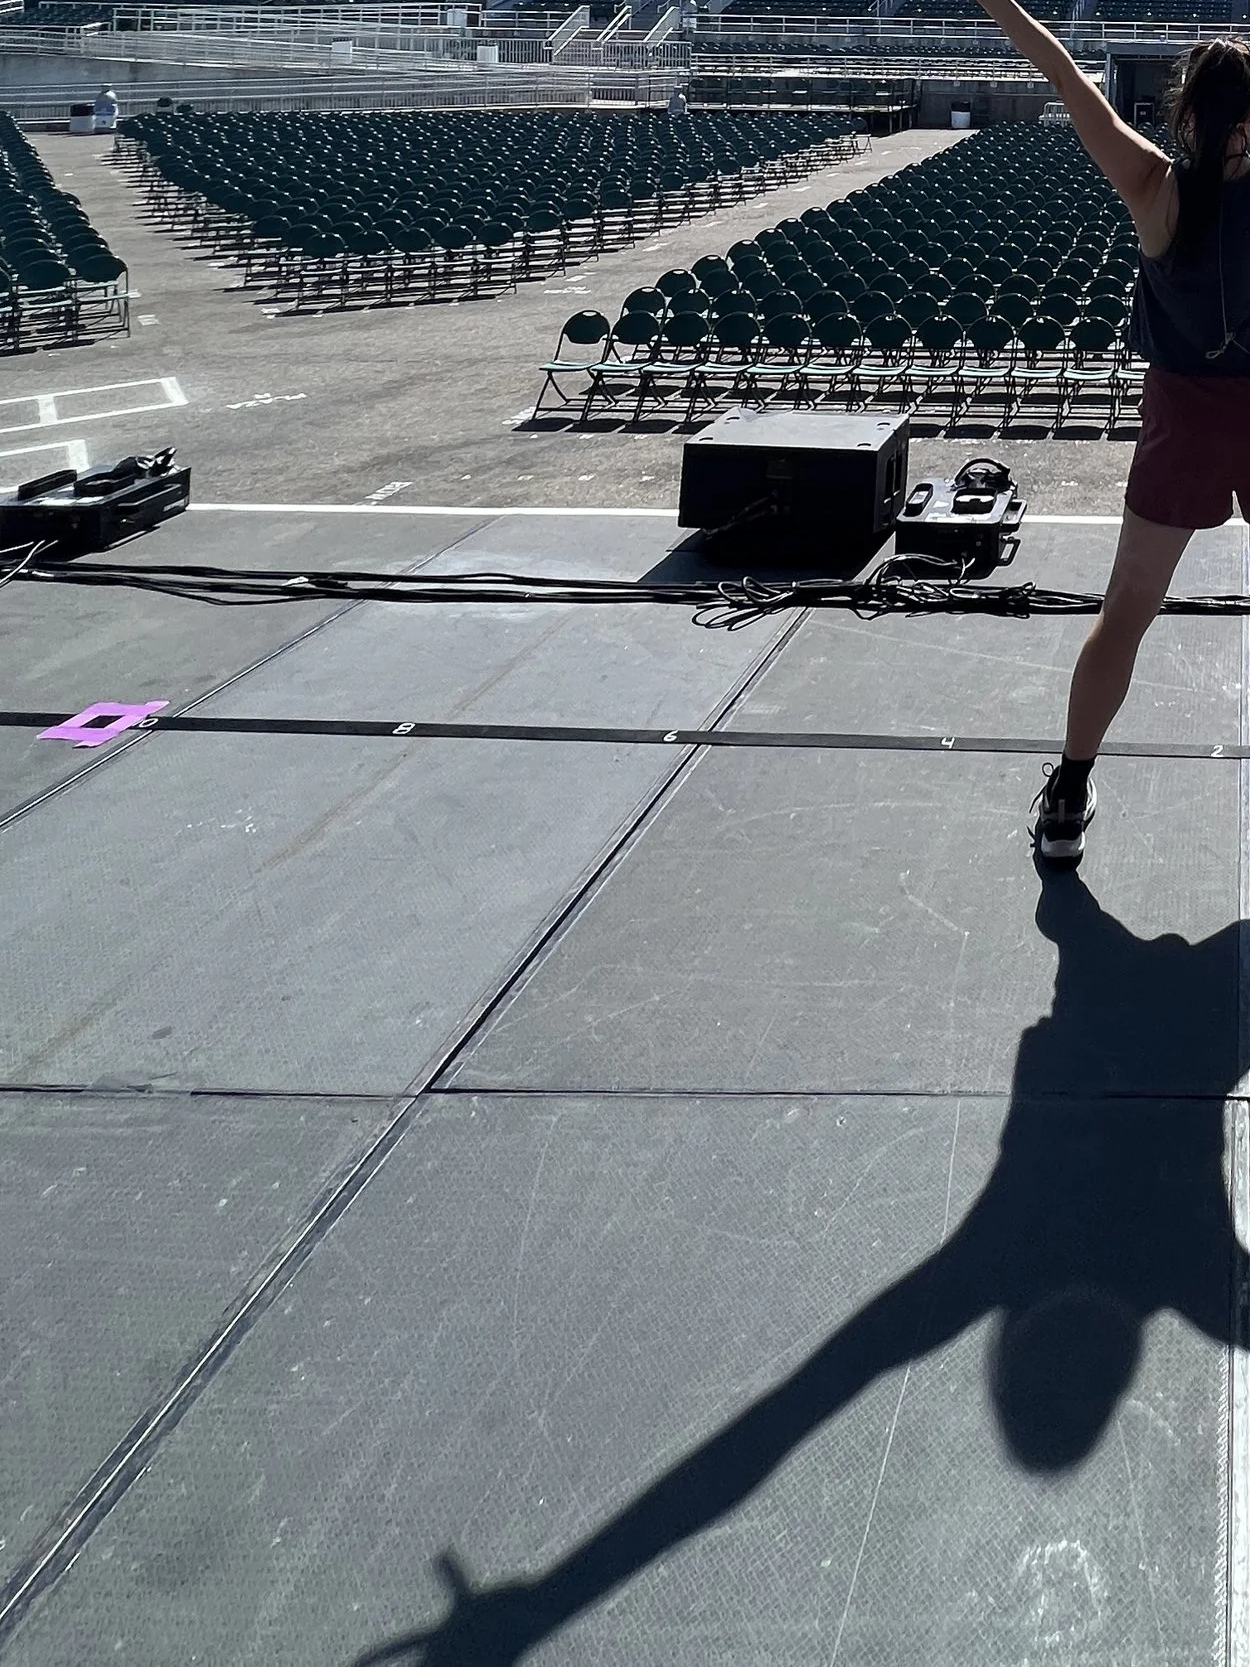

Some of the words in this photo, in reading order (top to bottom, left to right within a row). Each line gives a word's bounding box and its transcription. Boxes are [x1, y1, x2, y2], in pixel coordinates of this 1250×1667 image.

[391, 722, 416, 735] 8
[662, 729, 679, 742] 6
[941, 736, 956, 749] 4
[1210, 744, 1224, 758] 2
